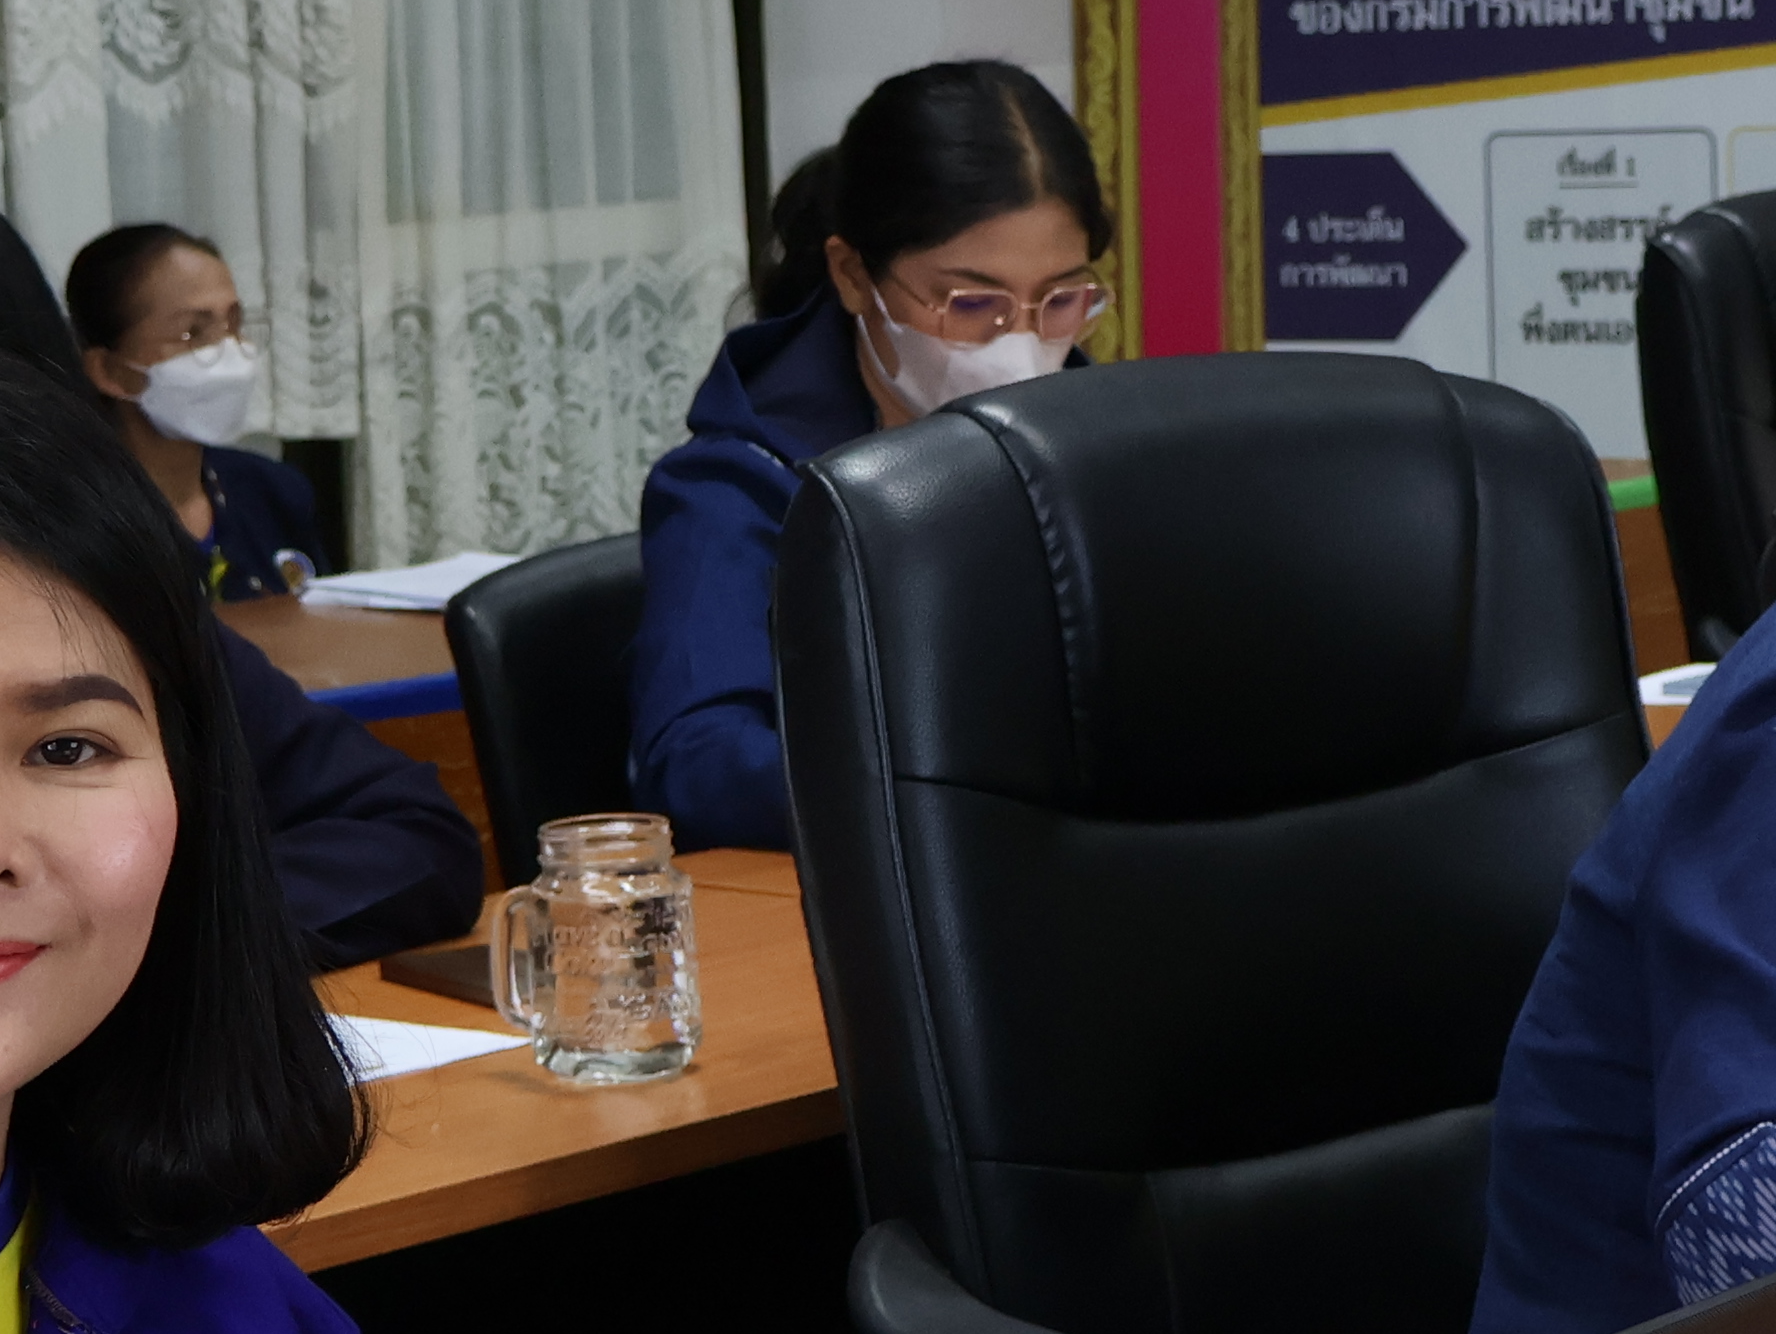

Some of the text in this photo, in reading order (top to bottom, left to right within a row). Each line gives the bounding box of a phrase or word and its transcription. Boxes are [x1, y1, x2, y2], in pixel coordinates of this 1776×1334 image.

[1280, 205, 1406, 244] 4 ประเด็น
[1278, 252, 1409, 288] การพัฒนา
